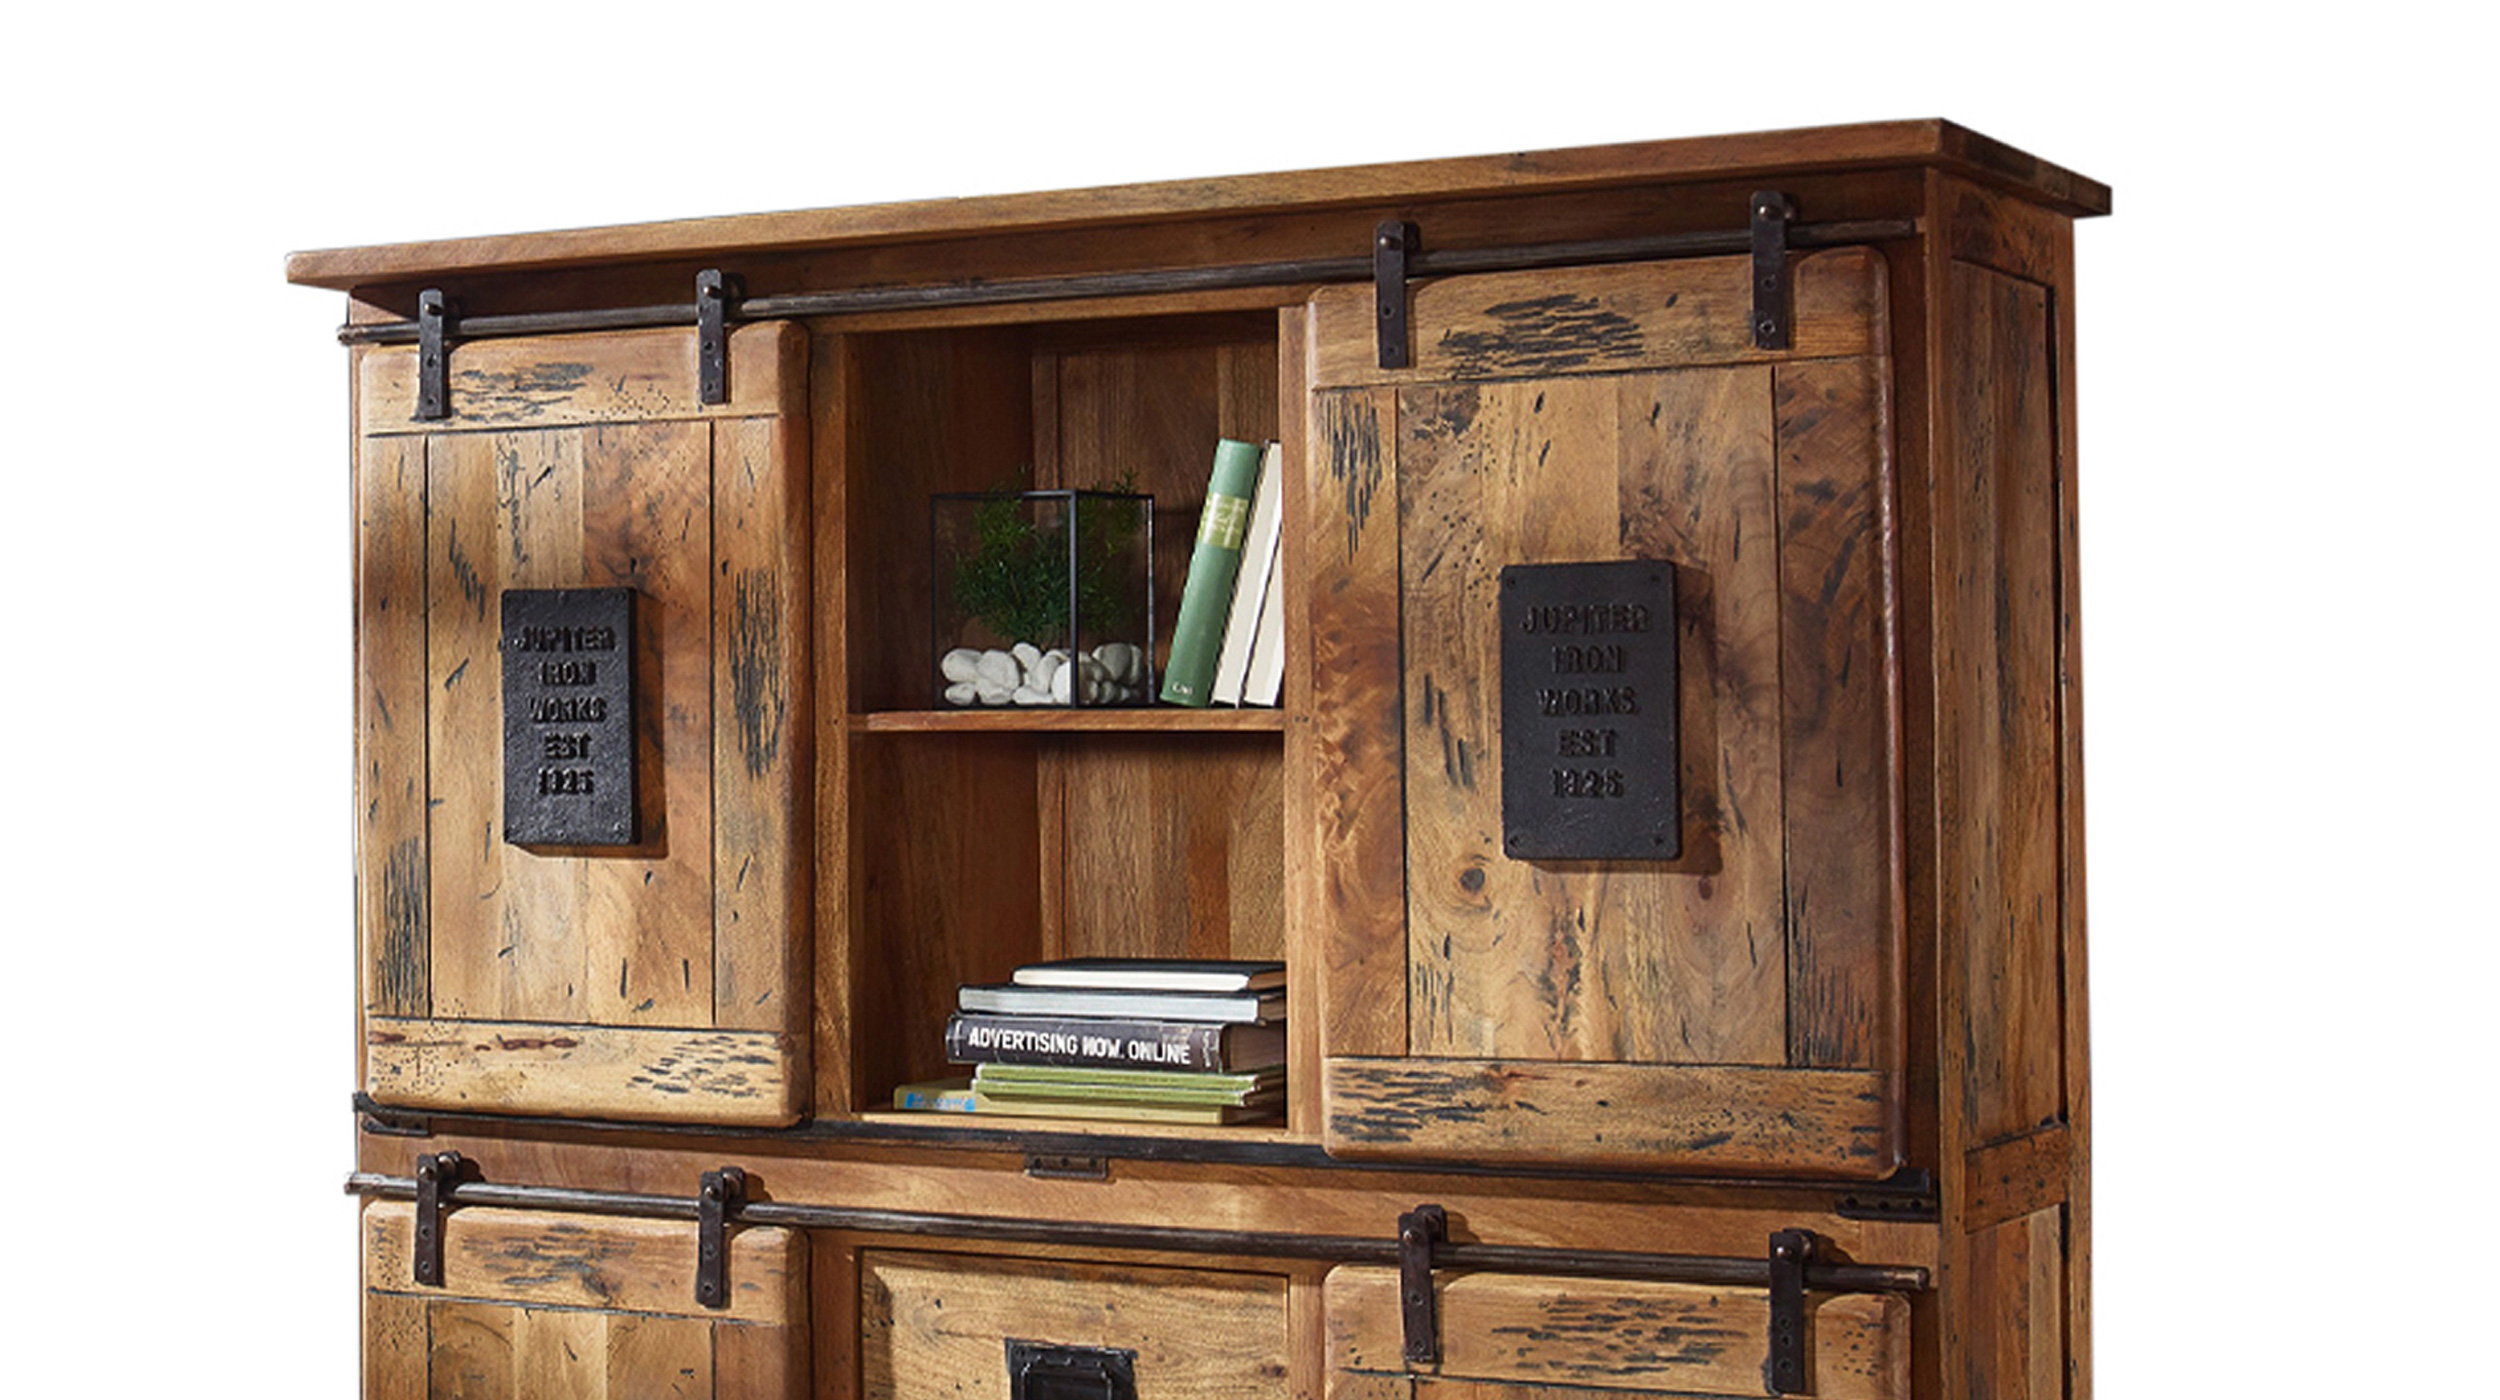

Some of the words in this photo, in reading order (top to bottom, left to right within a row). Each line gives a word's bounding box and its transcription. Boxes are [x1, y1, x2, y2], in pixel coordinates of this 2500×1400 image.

[1520, 605, 1650, 634] JUPITER
[512, 626, 618, 651] JUPITER
[538, 661, 597, 685] IRON
[1551, 645, 1626, 674] IRON
[528, 697, 607, 722] WORKS
[1536, 687, 1640, 716] WORKS
[544, 732, 592, 759] EST
[1557, 728, 1618, 758] EST
[968, 1027, 1078, 1055] ADVERTISING
[1128, 1040, 1191, 1065] ONLINE
